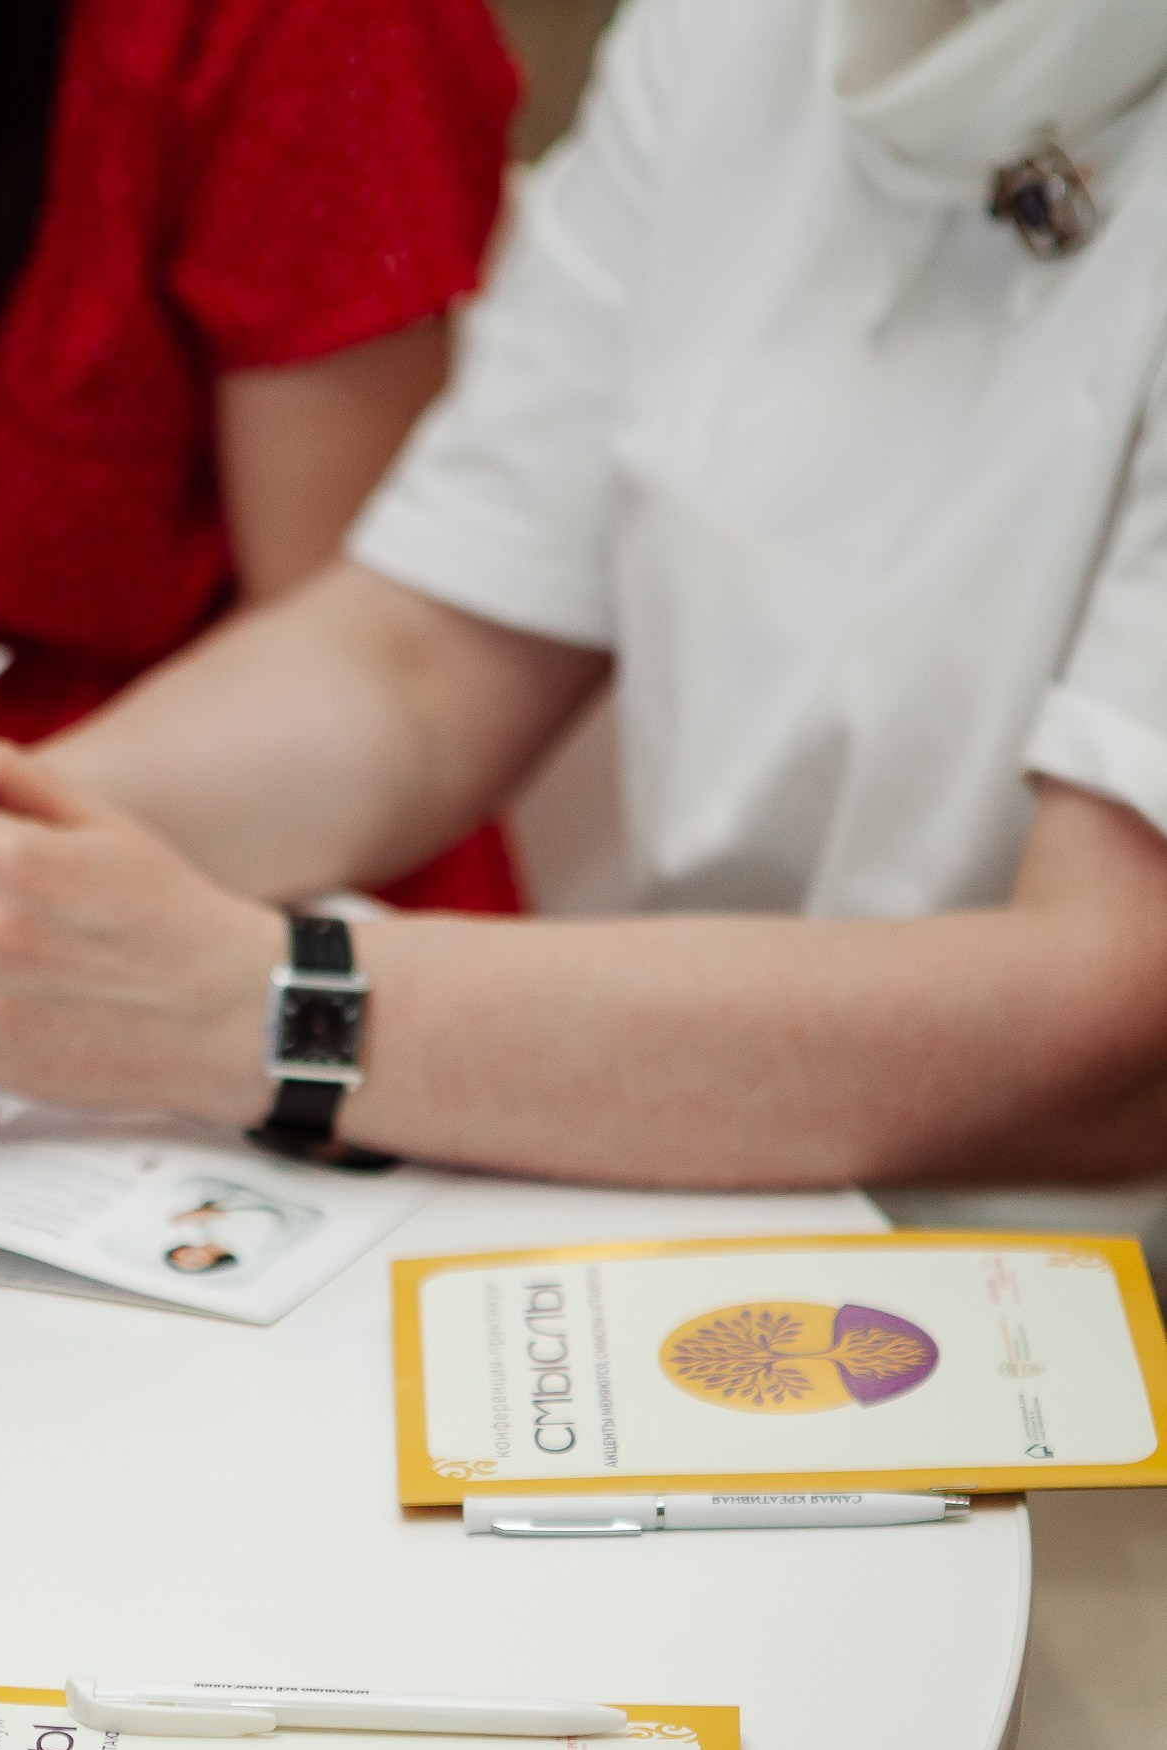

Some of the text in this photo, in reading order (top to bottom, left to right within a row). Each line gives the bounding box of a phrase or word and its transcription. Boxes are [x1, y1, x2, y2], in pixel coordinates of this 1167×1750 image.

[523, 1284, 576, 1455] СМЫСЛЫ
[601, 1416, 618, 1468] АКЦЕНТЫ
[712, 1495, 862, 1505] САМАЯ КРЕАТИВНАЯ
